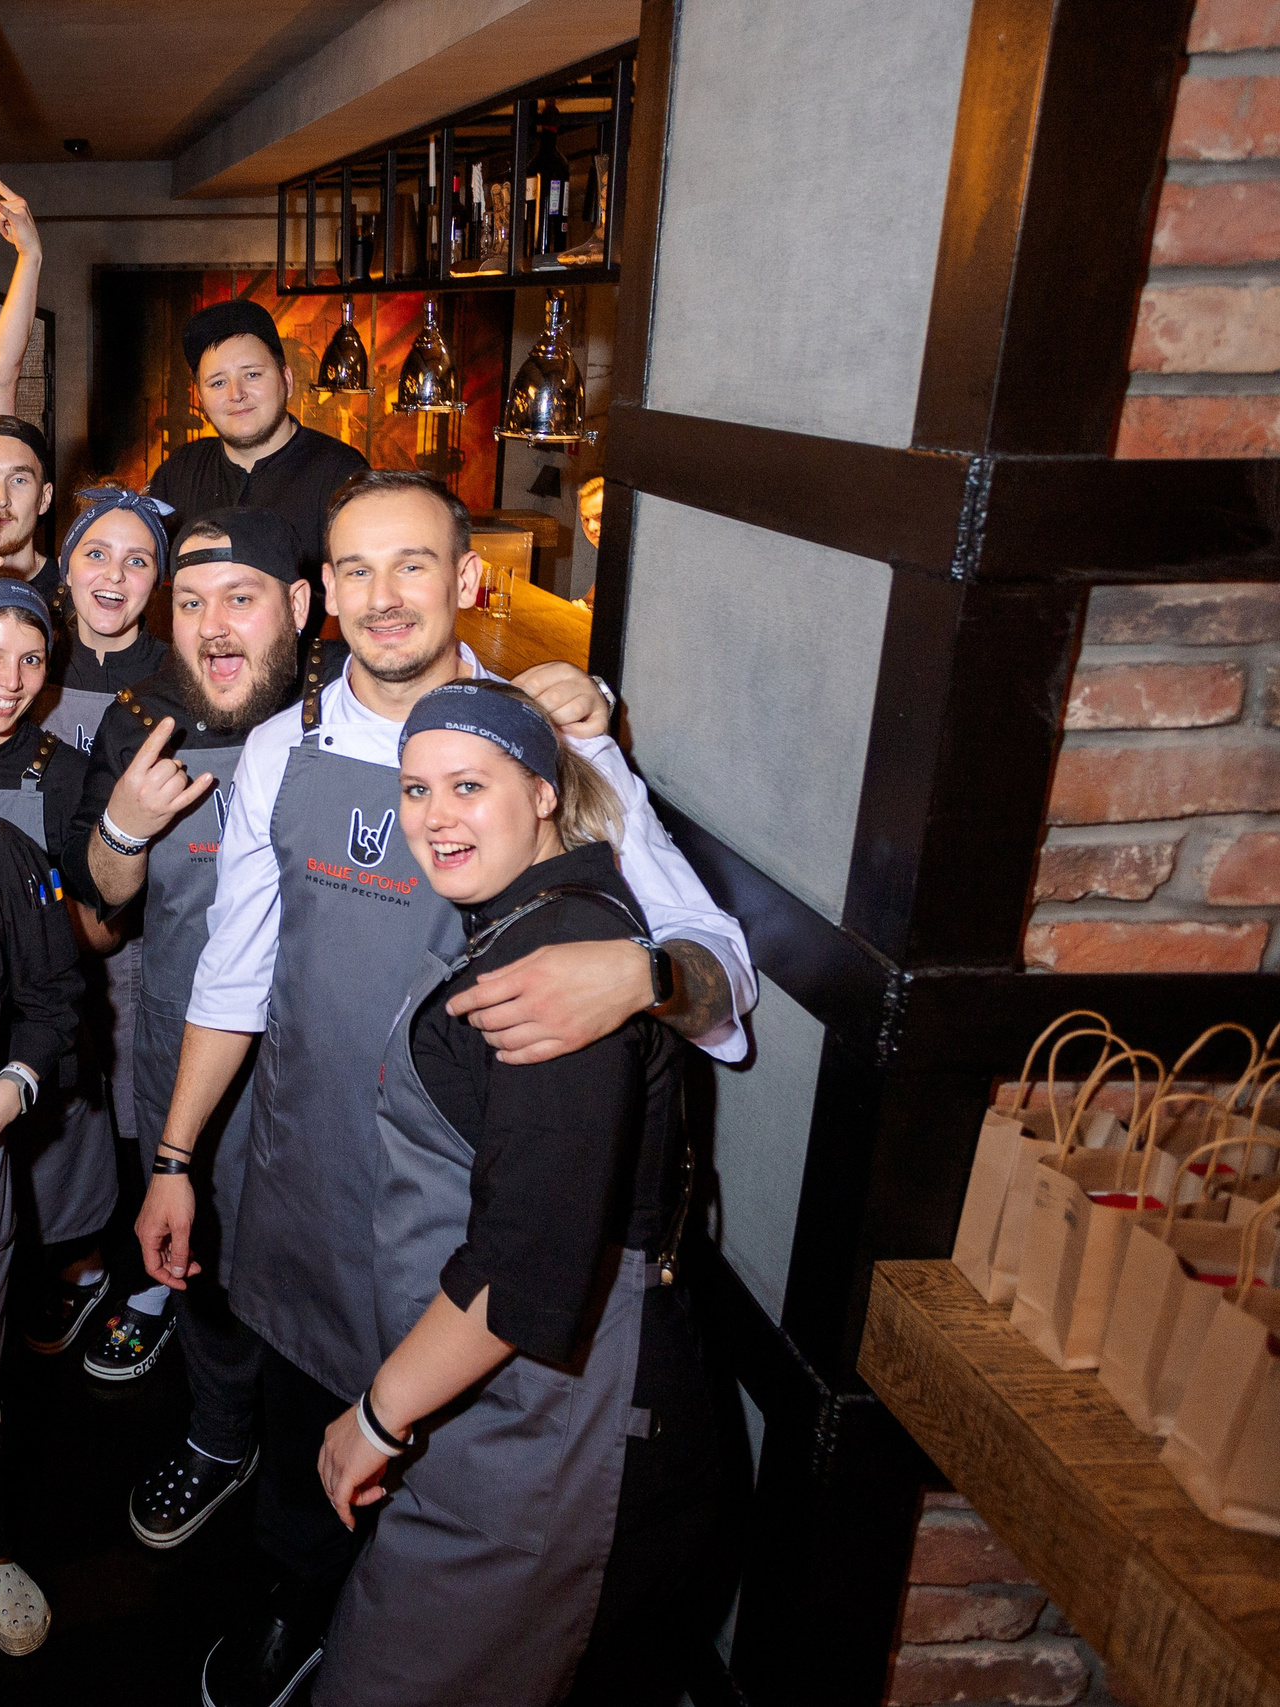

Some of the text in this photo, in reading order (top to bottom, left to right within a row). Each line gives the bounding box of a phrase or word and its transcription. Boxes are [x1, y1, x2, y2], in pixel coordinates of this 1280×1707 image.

[445, 721, 511, 750] ВАШЕ ОГОНЬ
[188, 842, 220, 853] ВАШ
[306, 857, 354, 881] ВАШЕ
[304, 874, 411, 908] МЯСНОЙ РЕСТОРАН
